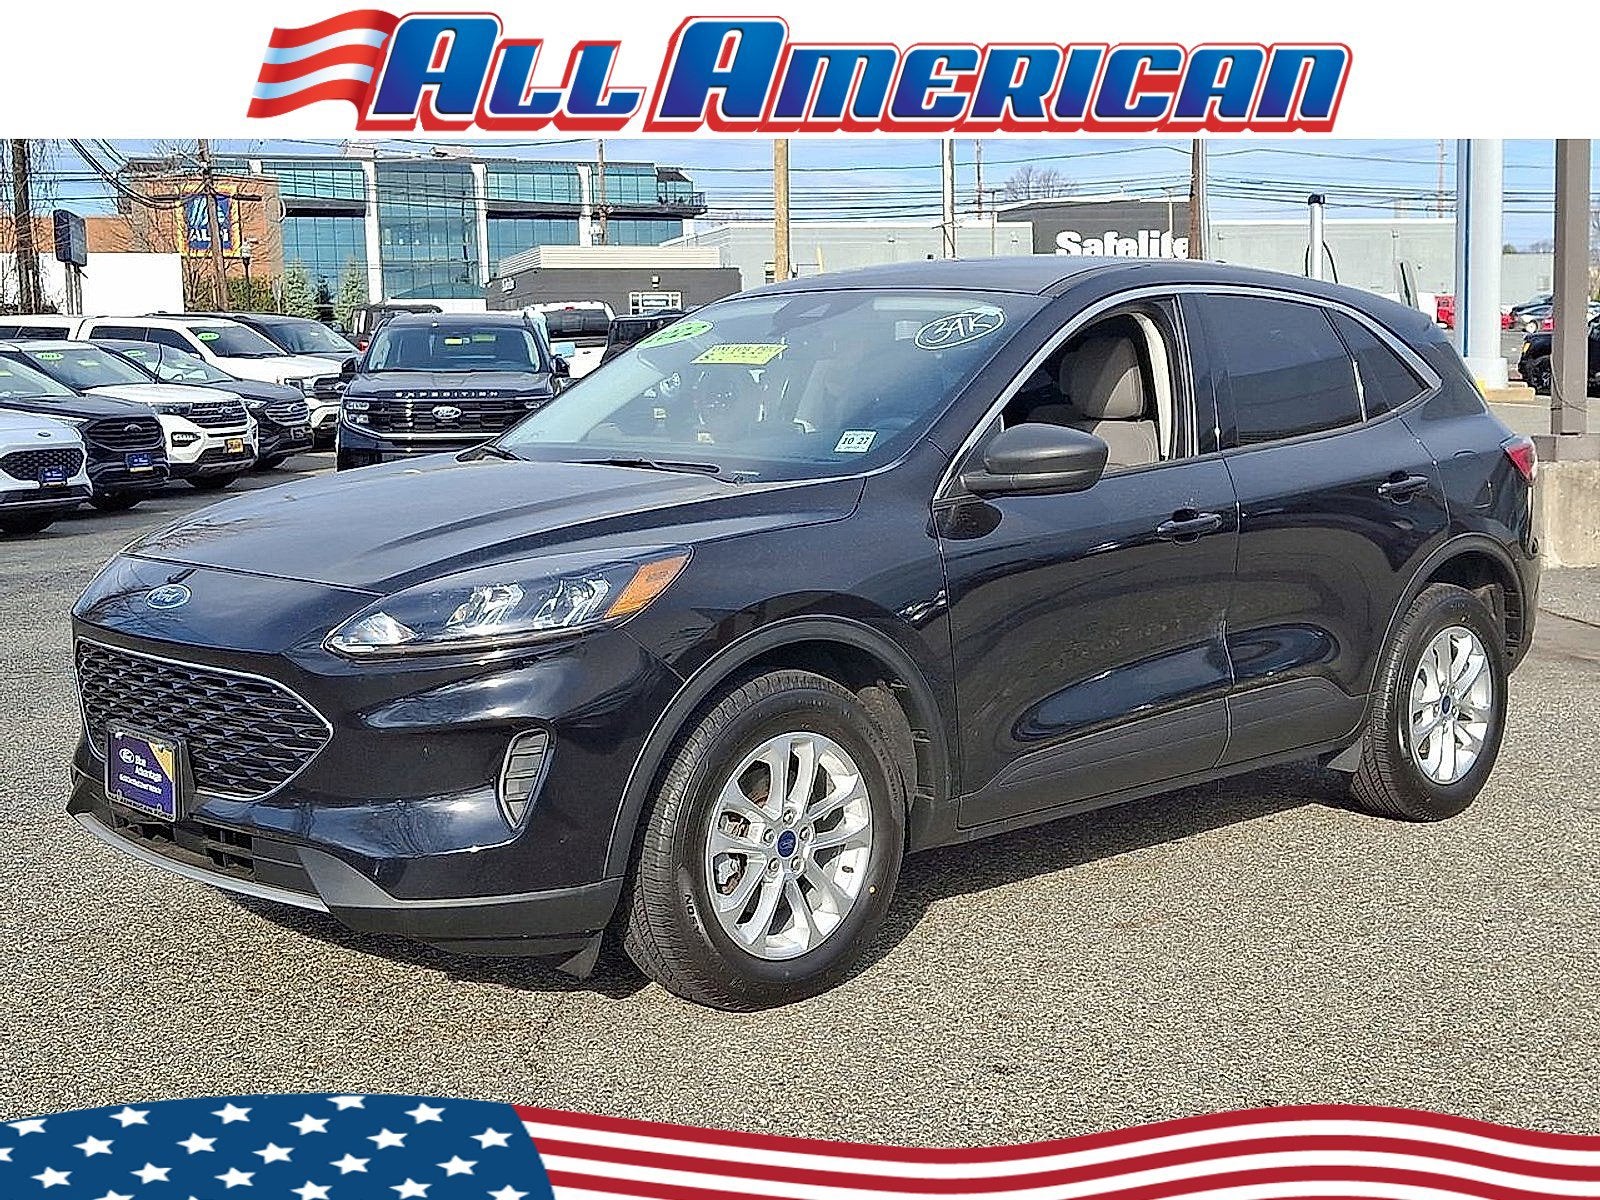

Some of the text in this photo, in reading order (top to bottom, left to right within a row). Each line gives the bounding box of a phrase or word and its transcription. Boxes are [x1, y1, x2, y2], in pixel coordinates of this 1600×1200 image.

[190, 228, 229, 242] ALI
[841, 437, 871, 445] 10 27
